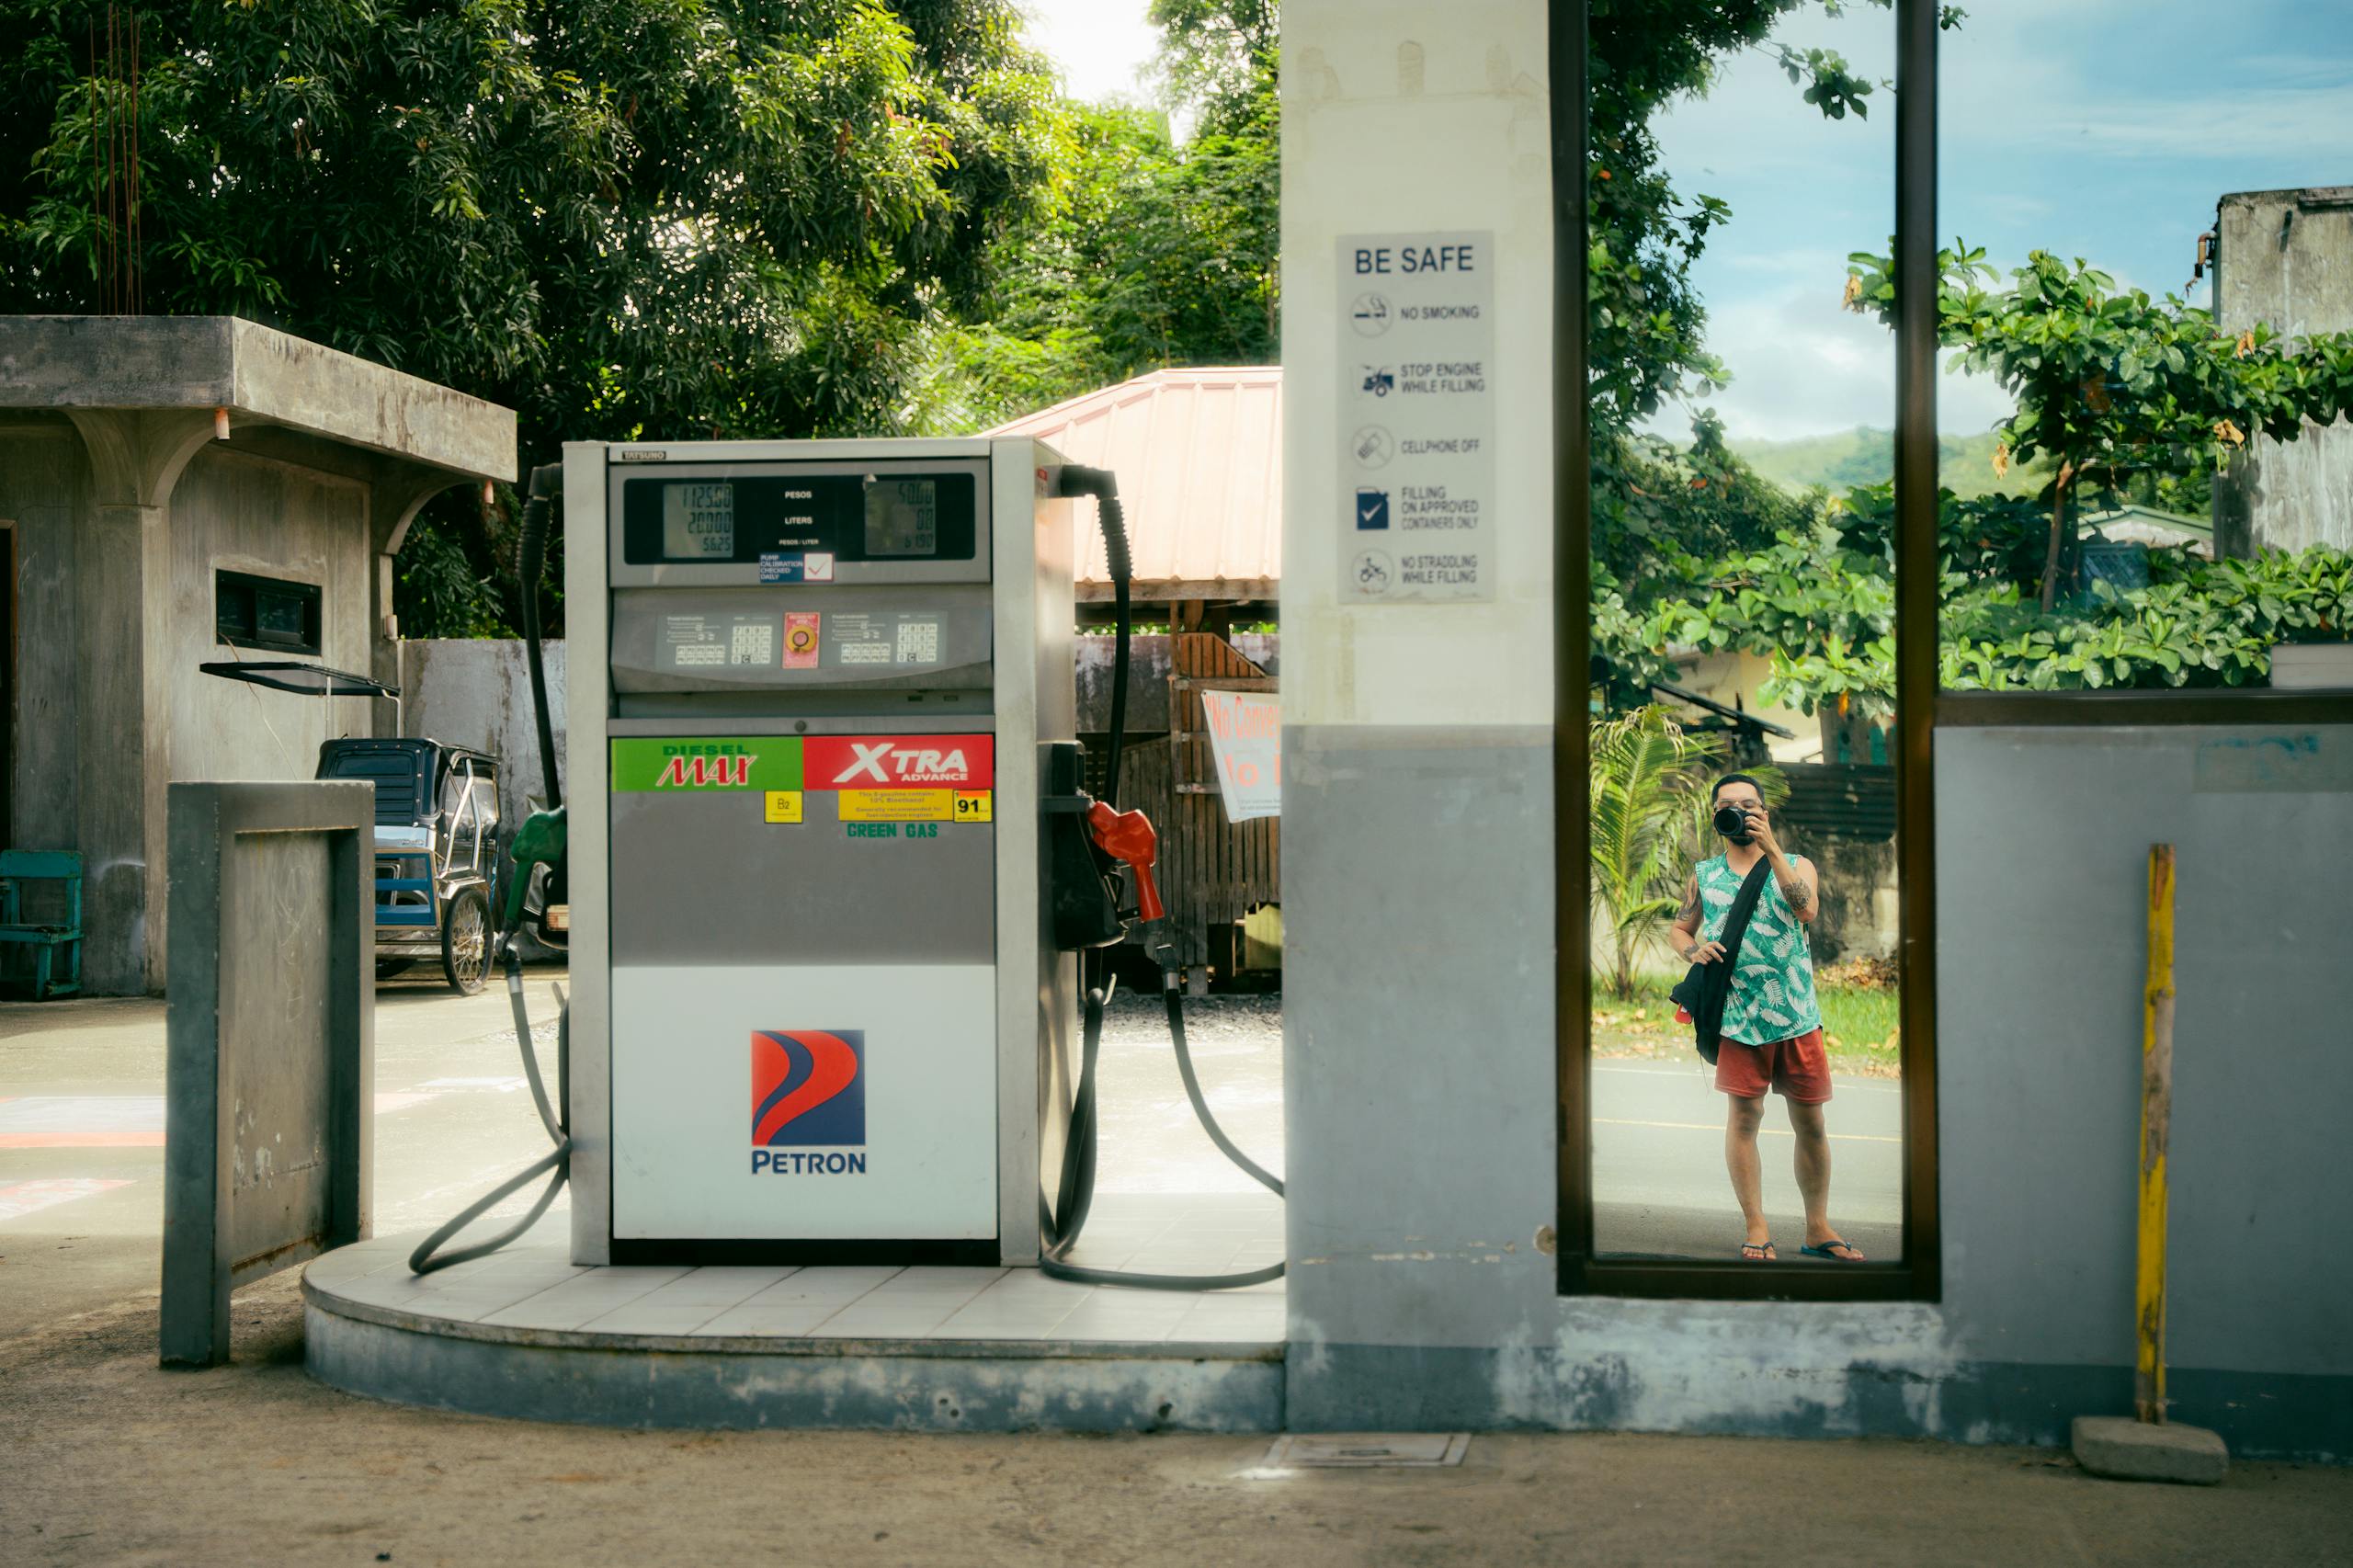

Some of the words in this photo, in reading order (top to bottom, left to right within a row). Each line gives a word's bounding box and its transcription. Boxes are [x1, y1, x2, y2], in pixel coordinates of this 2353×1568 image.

[1356, 248, 1392, 274] BE
[1401, 245, 1473, 273] SAFE
[1401, 307, 1418, 320] NO
[1422, 305, 1480, 320] SMOKING
[1401, 364, 1433, 377] STOP
[1437, 362, 1483, 376] ENGINE
[1401, 381, 1438, 393] WHILE
[1441, 379, 1484, 392] FILLING
[1401, 440, 1459, 454] CELLPHONE
[1461, 438, 1480, 452] OFF
[1402, 486, 1446, 500] FILLING
[1402, 502, 1417, 514] ON
[1420, 500, 1479, 514] APPROVED
[1402, 556, 1415, 569] NO
[1417, 554, 1477, 569] STRADDLING
[1402, 571, 1434, 584] WHILE
[1437, 570, 1477, 584] FILLING
[663, 744, 750, 756] DIESEL
[832, 743, 968, 782] XTRA
[655, 756, 757, 787] MAX
[901, 773, 969, 781] ADVANCE
[778, 798, 790, 810] B2
[957, 799, 979, 813] 91
[847, 823, 897, 838] GREEN
[905, 823, 938, 838] GAS
[751, 1150, 866, 1175] PETRON
